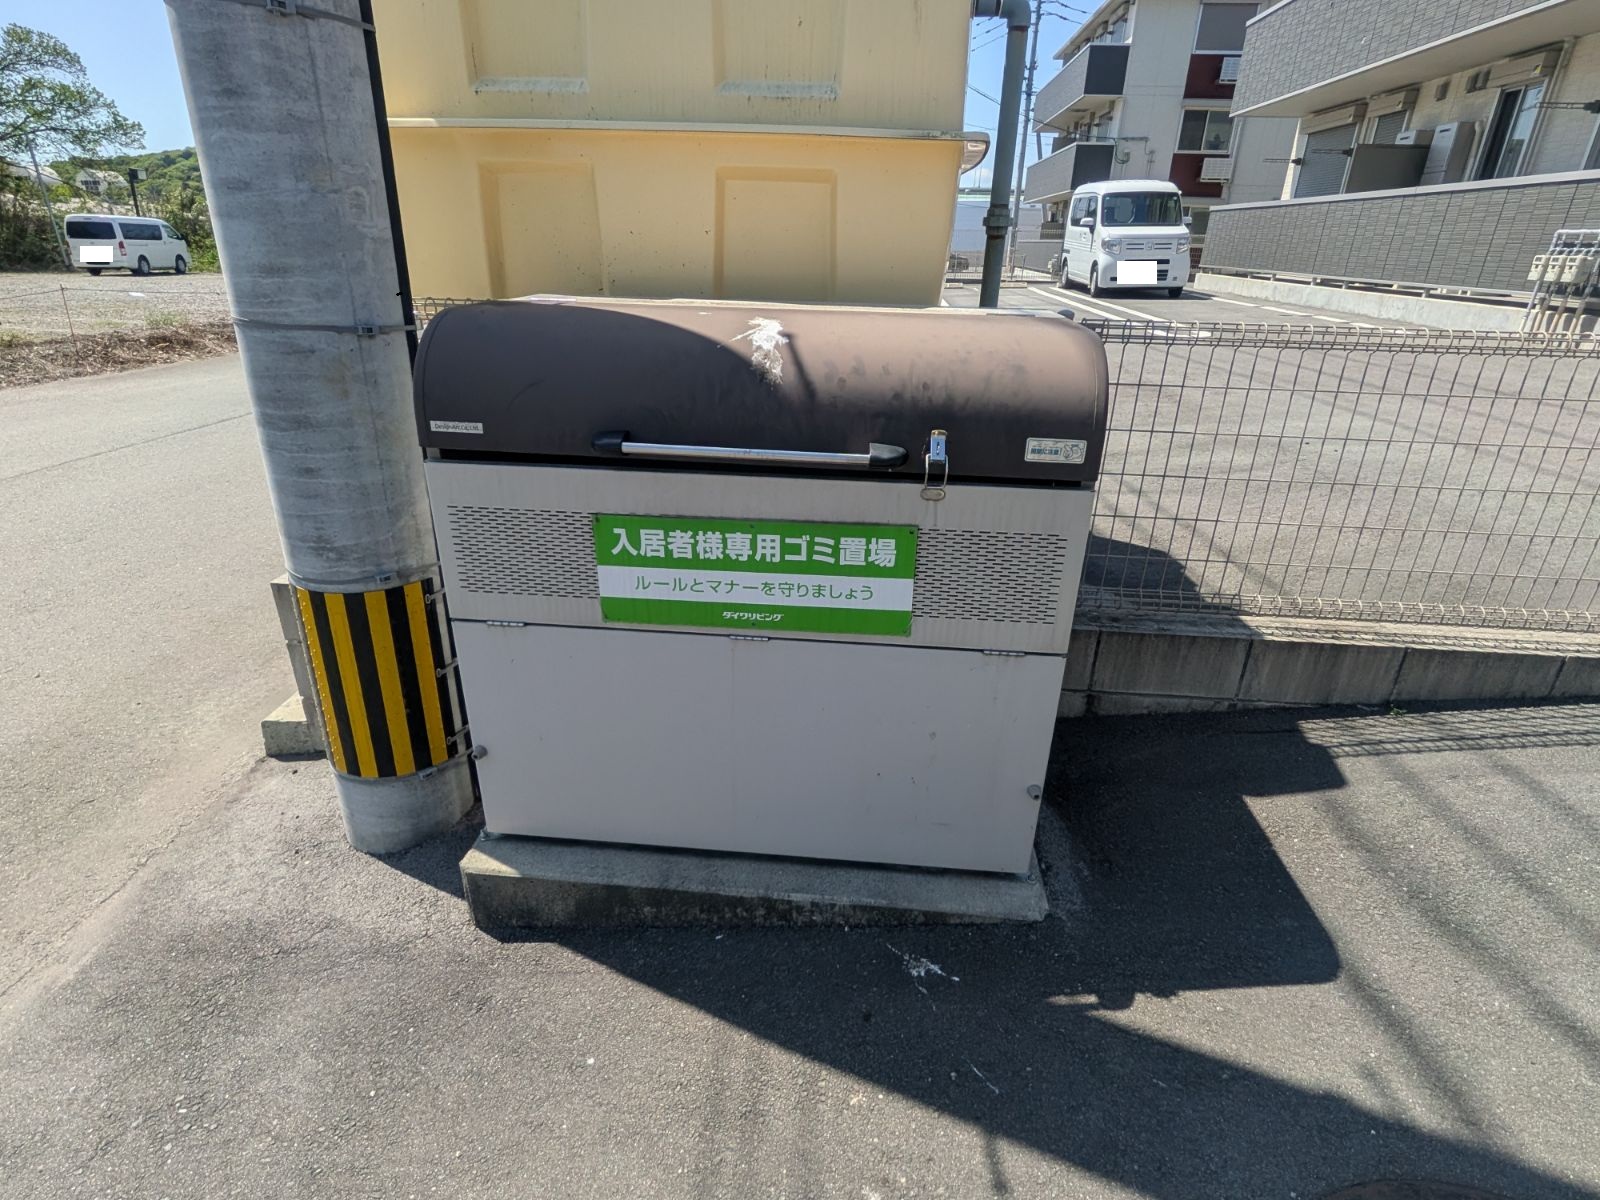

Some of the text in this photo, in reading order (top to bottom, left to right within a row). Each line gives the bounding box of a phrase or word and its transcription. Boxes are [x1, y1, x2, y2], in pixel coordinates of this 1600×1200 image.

[611, 527, 897, 568] 入居者様専用ゴミ置場
[635, 575, 874, 601] ルールとマナーを守りましょう
[722, 611, 784, 622] ダイワリビング
